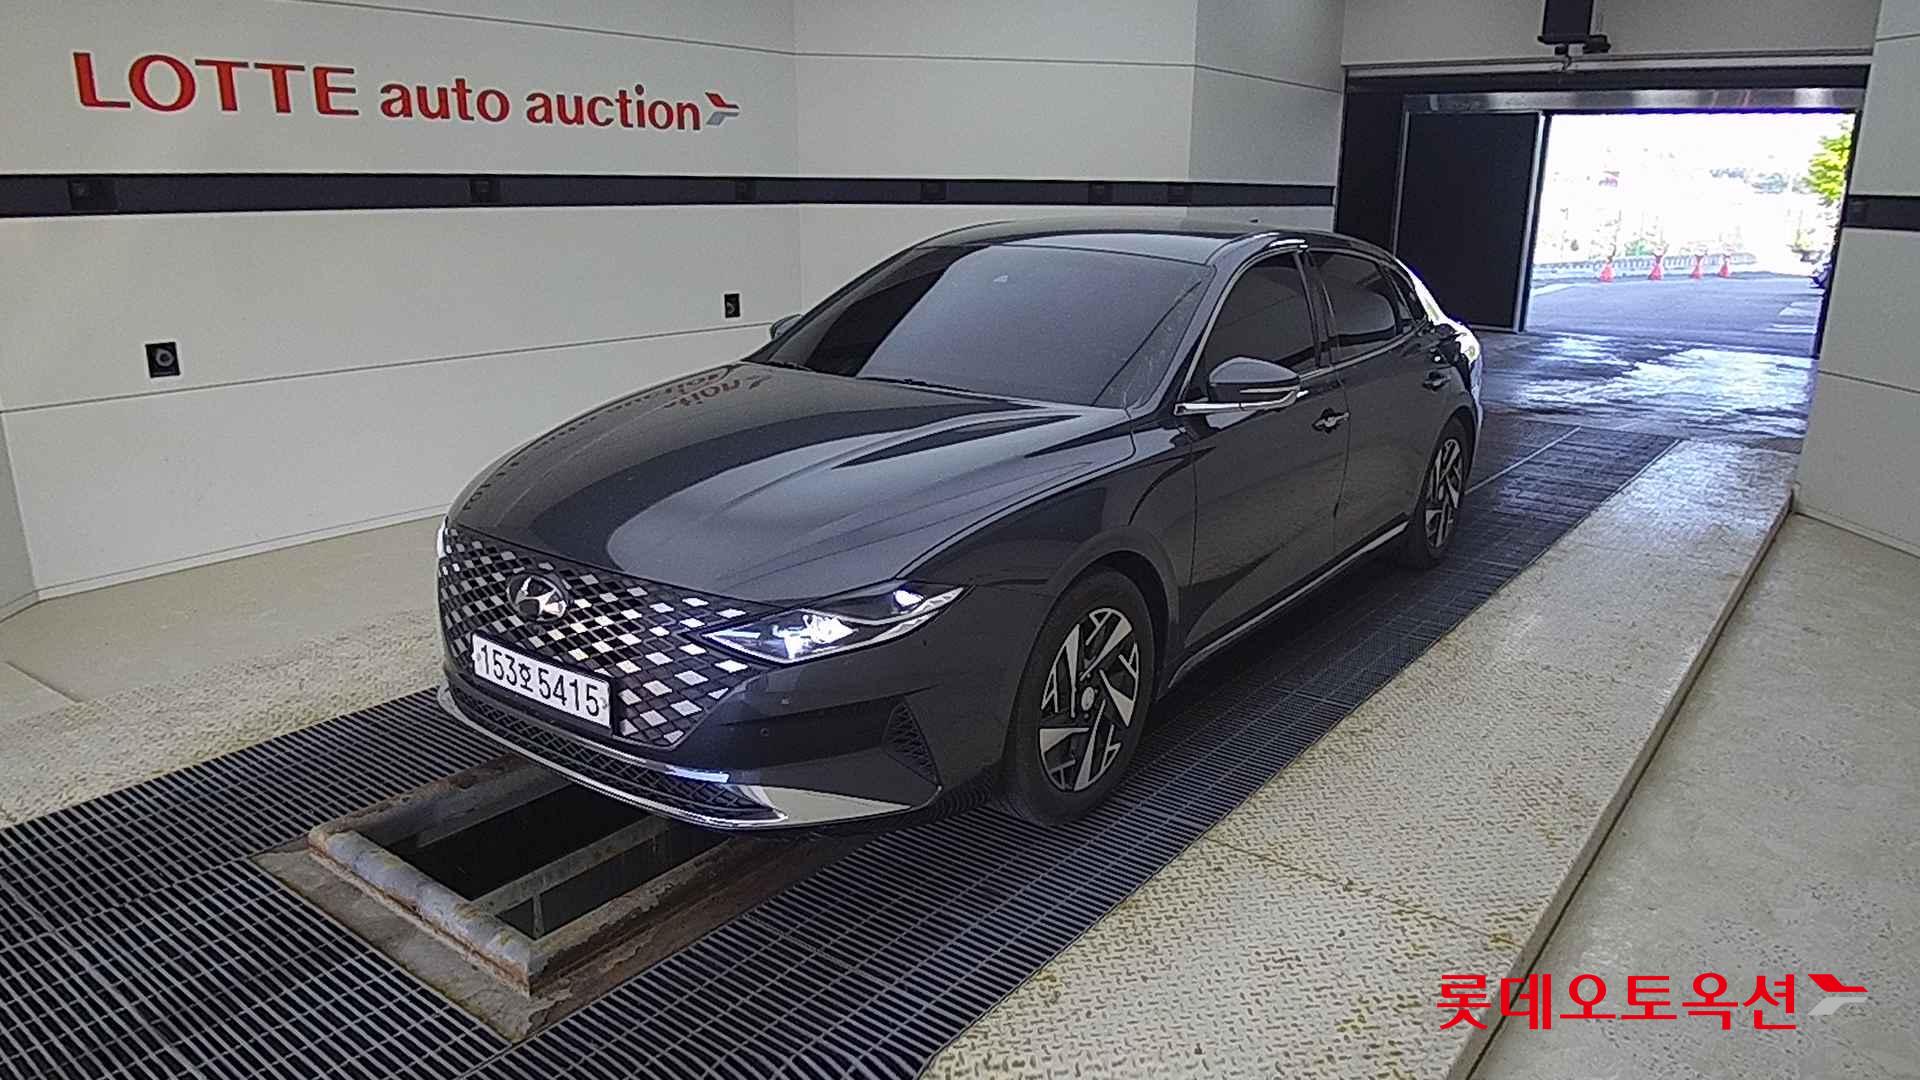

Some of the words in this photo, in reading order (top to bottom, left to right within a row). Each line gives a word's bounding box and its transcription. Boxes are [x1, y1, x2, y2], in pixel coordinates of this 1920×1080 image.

[73, 52, 360, 117] LOTTE
[380, 78, 510, 122] auto
[526, 84, 701, 131] auction
[538, 667, 600, 717] 5415
